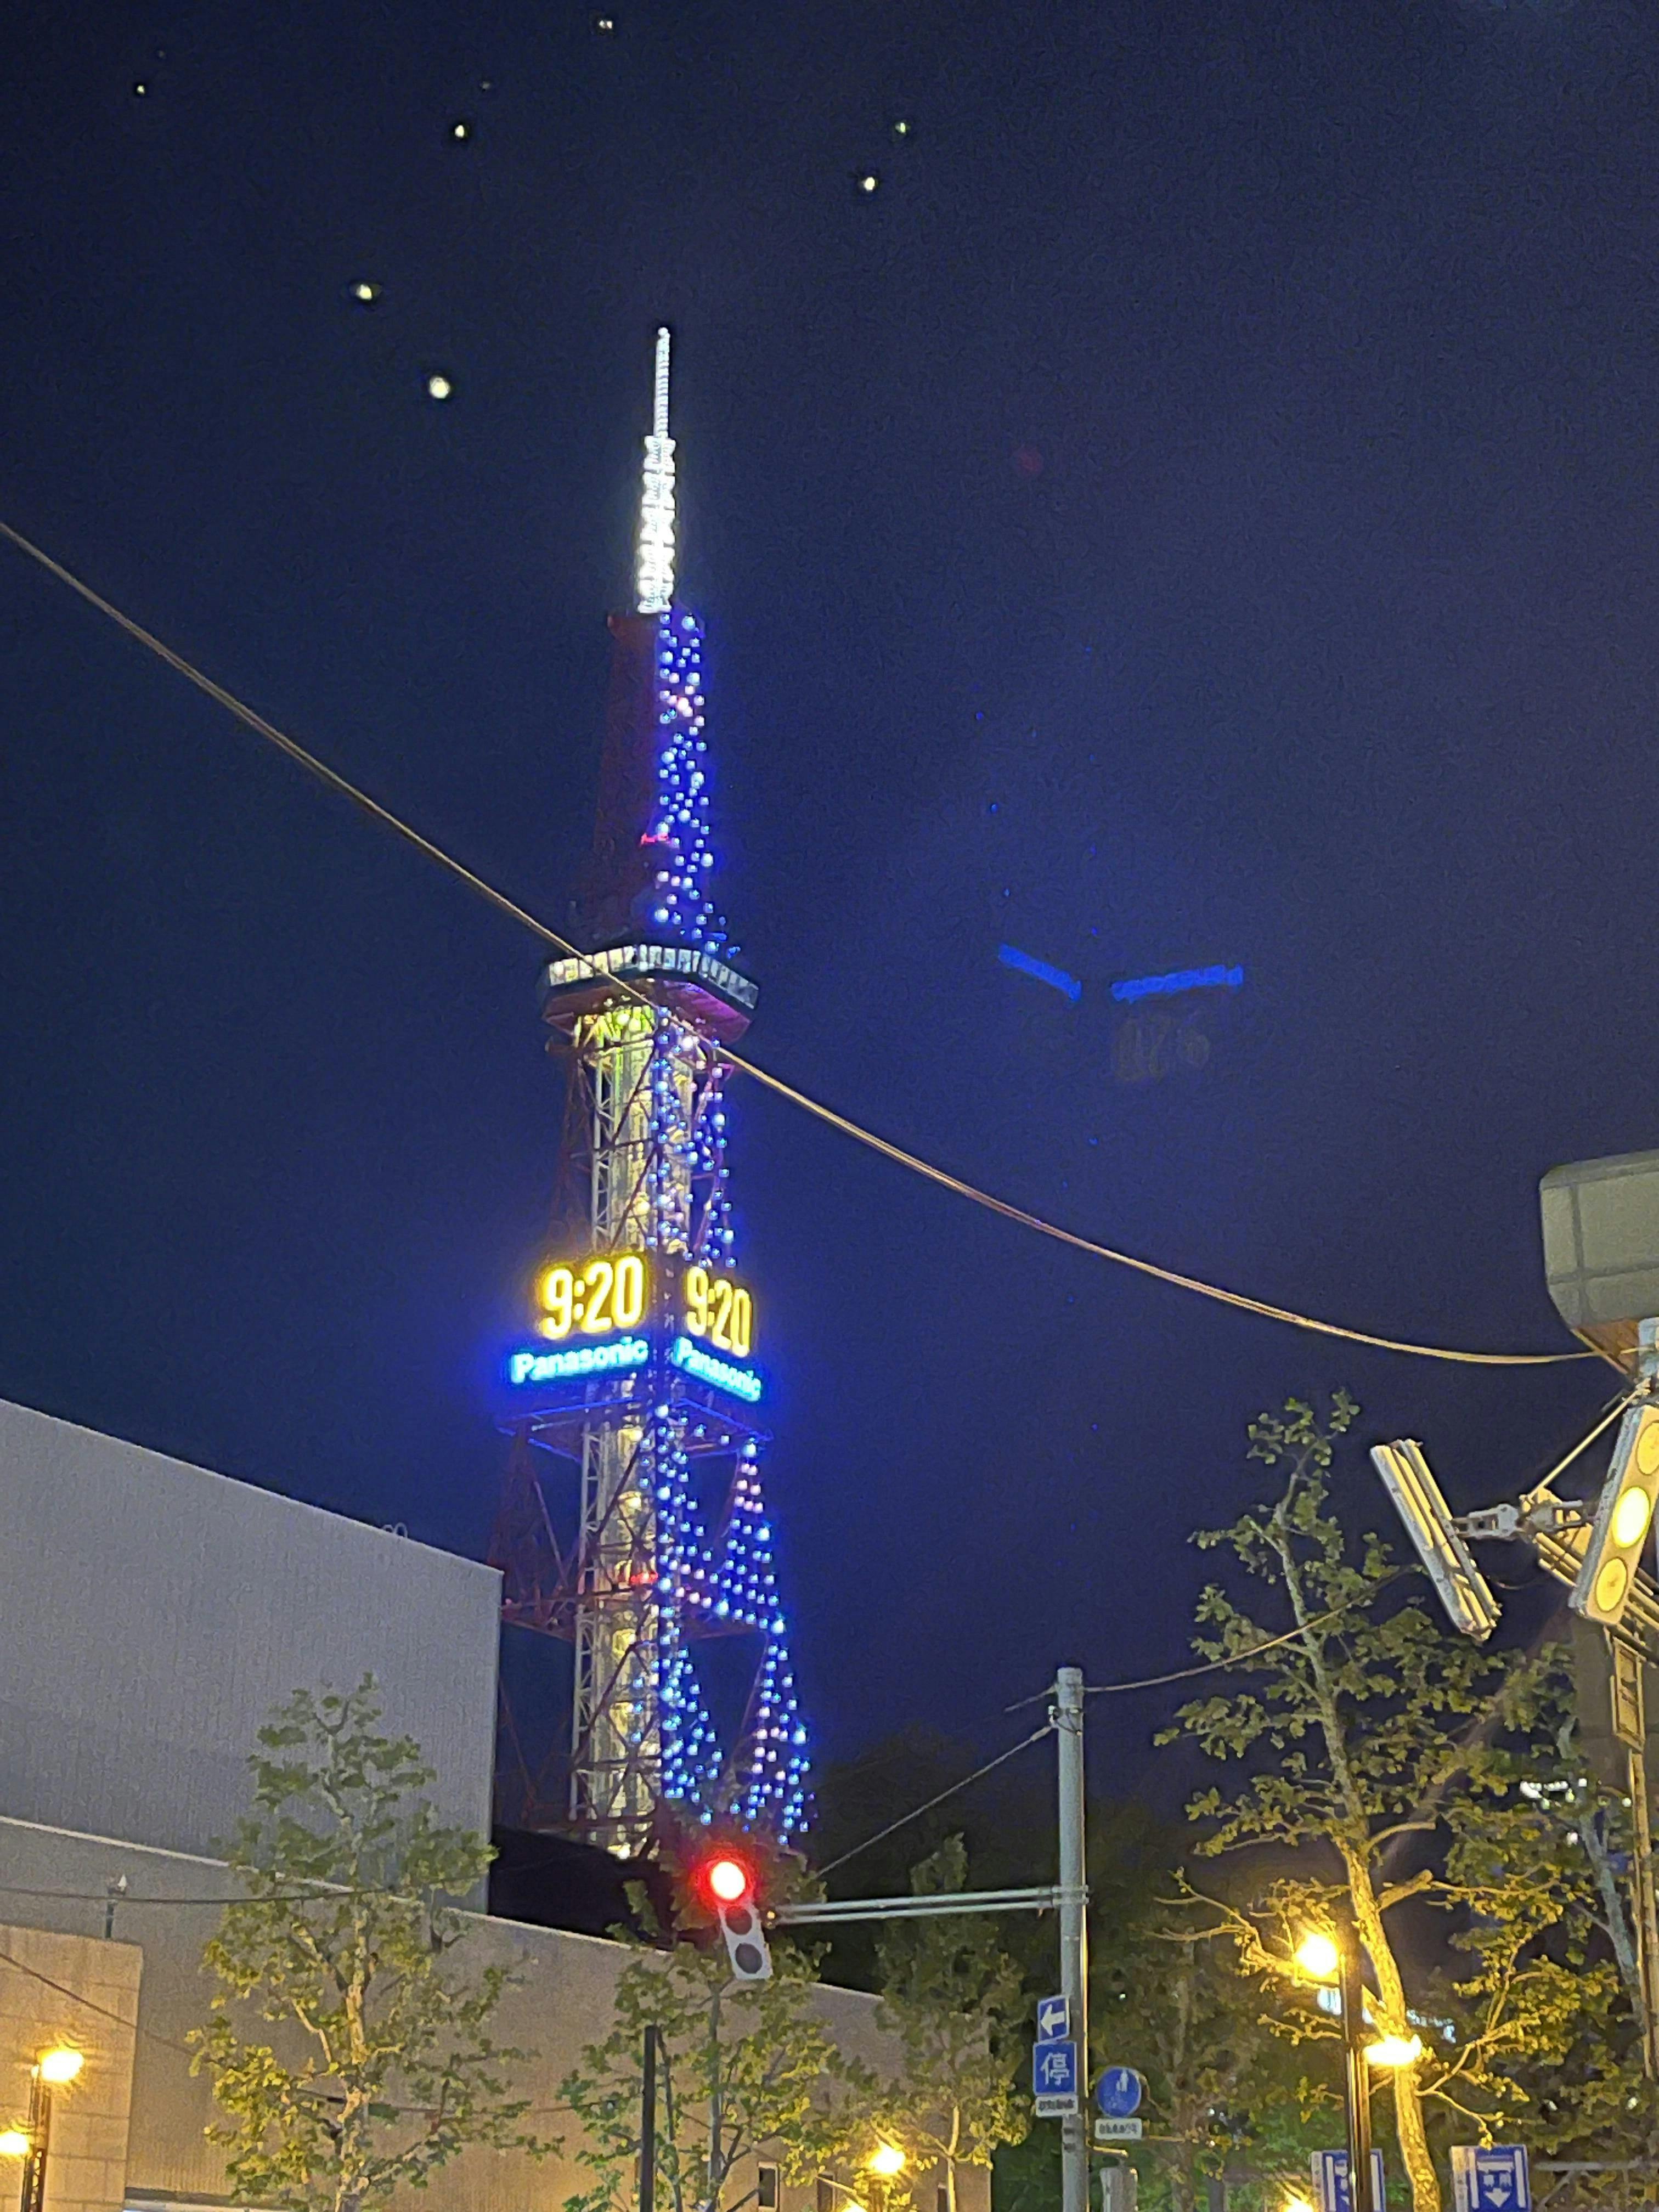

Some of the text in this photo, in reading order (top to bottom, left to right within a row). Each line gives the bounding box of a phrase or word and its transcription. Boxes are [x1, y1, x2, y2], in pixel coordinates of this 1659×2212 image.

[541, 1255, 644, 1340] 9:20
[686, 1266, 751, 1357] 9:20
[512, 1336, 648, 1383] Panasonic
[674, 1337, 761, 1401] Panasonic
[1040, 2052, 1070, 2085] 停
